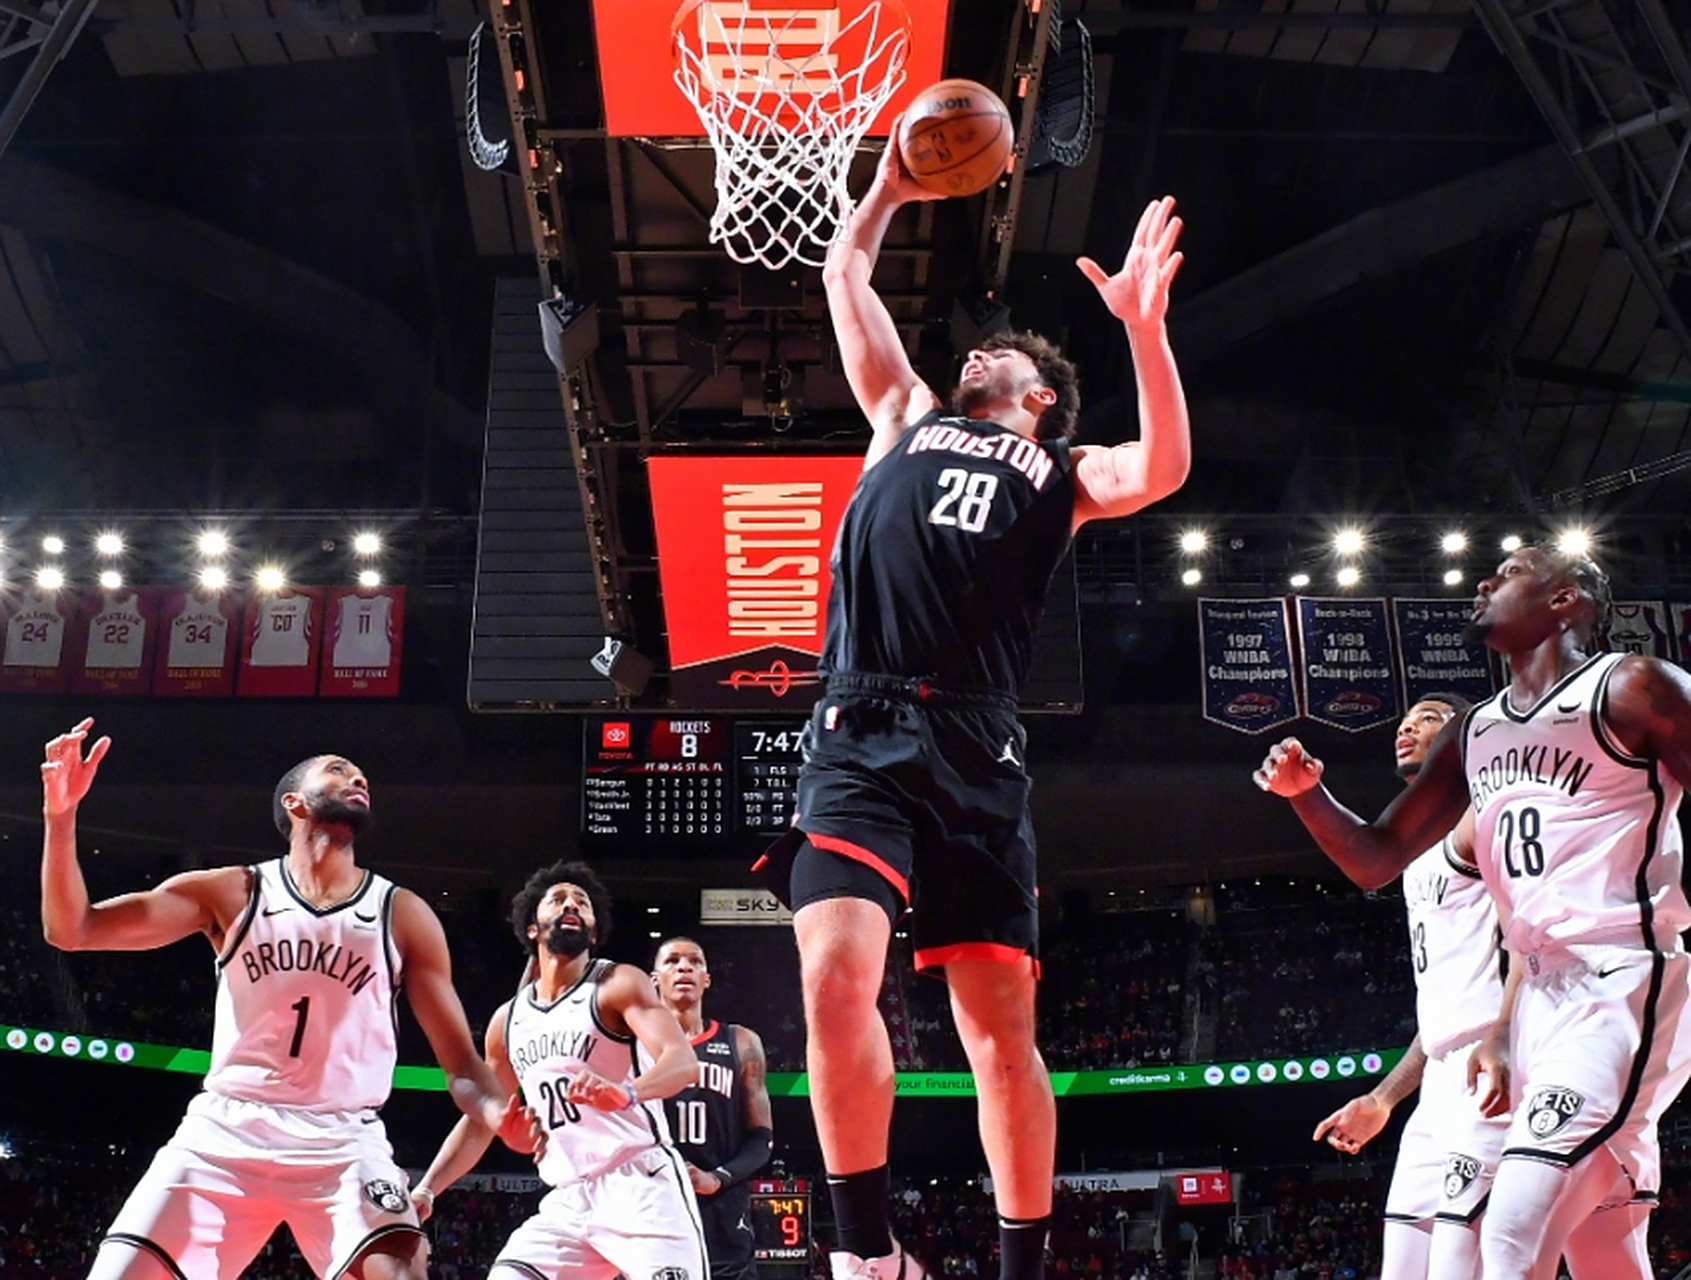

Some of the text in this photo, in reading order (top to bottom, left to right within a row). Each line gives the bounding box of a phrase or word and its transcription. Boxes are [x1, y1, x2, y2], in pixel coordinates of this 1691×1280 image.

[906, 424, 1054, 492] HOUSTON
[927, 468, 999, 533] 28
[722, 483, 823, 636] HOUSTON
[21, 622, 50, 642] 24
[103, 624, 130, 644] 22
[185, 624, 213, 644] 34
[358, 614, 371, 634] 11
[1227, 634, 1263, 648] 1997
[1327, 633, 1365, 646] 1998
[1425, 633, 1463, 646] 1999
[1223, 651, 1271, 664] WNBA
[1323, 649, 1371, 662] WNBA
[1421, 649, 1470, 662] WNBA
[1208, 665, 1289, 683] Champions
[1308, 664, 1390, 682] Champions
[1407, 665, 1487, 681] Champions
[670, 721, 711, 733] ROCKETS
[681, 734, 698, 757] 8
[752, 731, 803, 752] 7:47
[598, 752, 633, 760] TOYOTA
[1471, 745, 1593, 814] BROOKLYN
[1499, 807, 1544, 878] 28
[736, 899, 780, 912] SKY
[242, 939, 377, 996] BROOKLYN
[289, 996, 310, 1058] 1
[894, 1080, 921, 1091] your
[539, 1076, 581, 1130] 26
[1532, 1088, 1578, 1114] NETS
[676, 1101, 706, 1145] 10
[501, 1179, 541, 1190] ULTR
[769, 1199, 803, 1215] 7:47
[781, 1216, 798, 1245] 9
[768, 1248, 807, 1258] TISSOT
